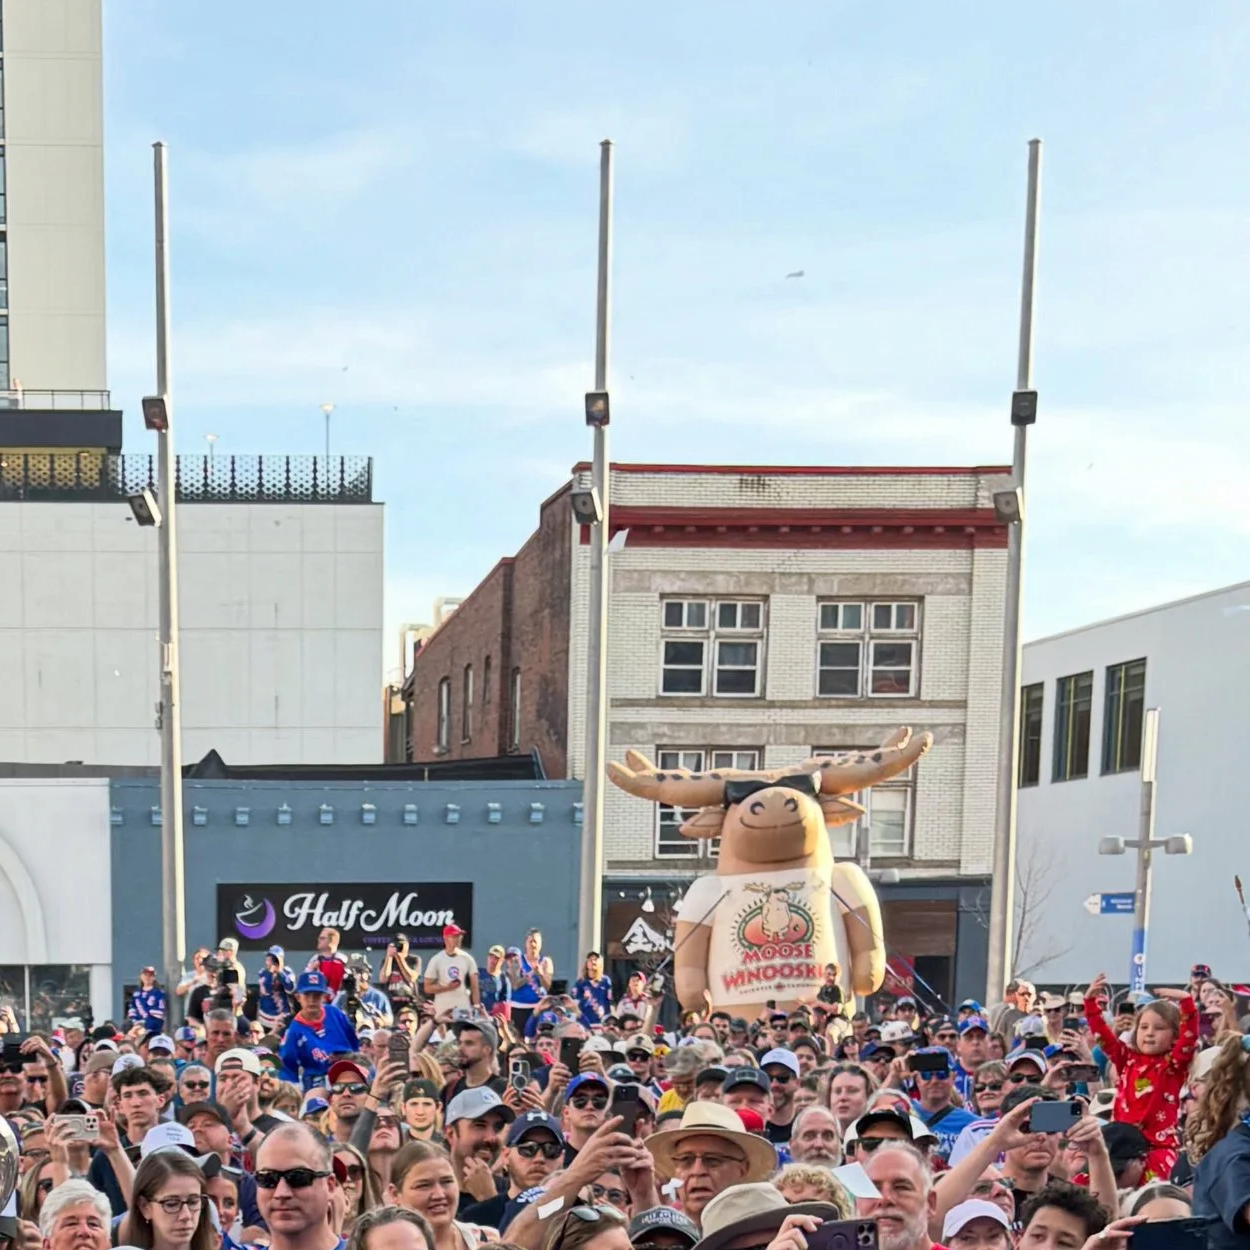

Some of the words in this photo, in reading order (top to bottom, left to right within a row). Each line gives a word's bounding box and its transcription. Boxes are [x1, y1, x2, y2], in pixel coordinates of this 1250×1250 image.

[283, 892, 364, 931] Half
[360, 892, 455, 932] Moon
[742, 944, 814, 965] MOOSE
